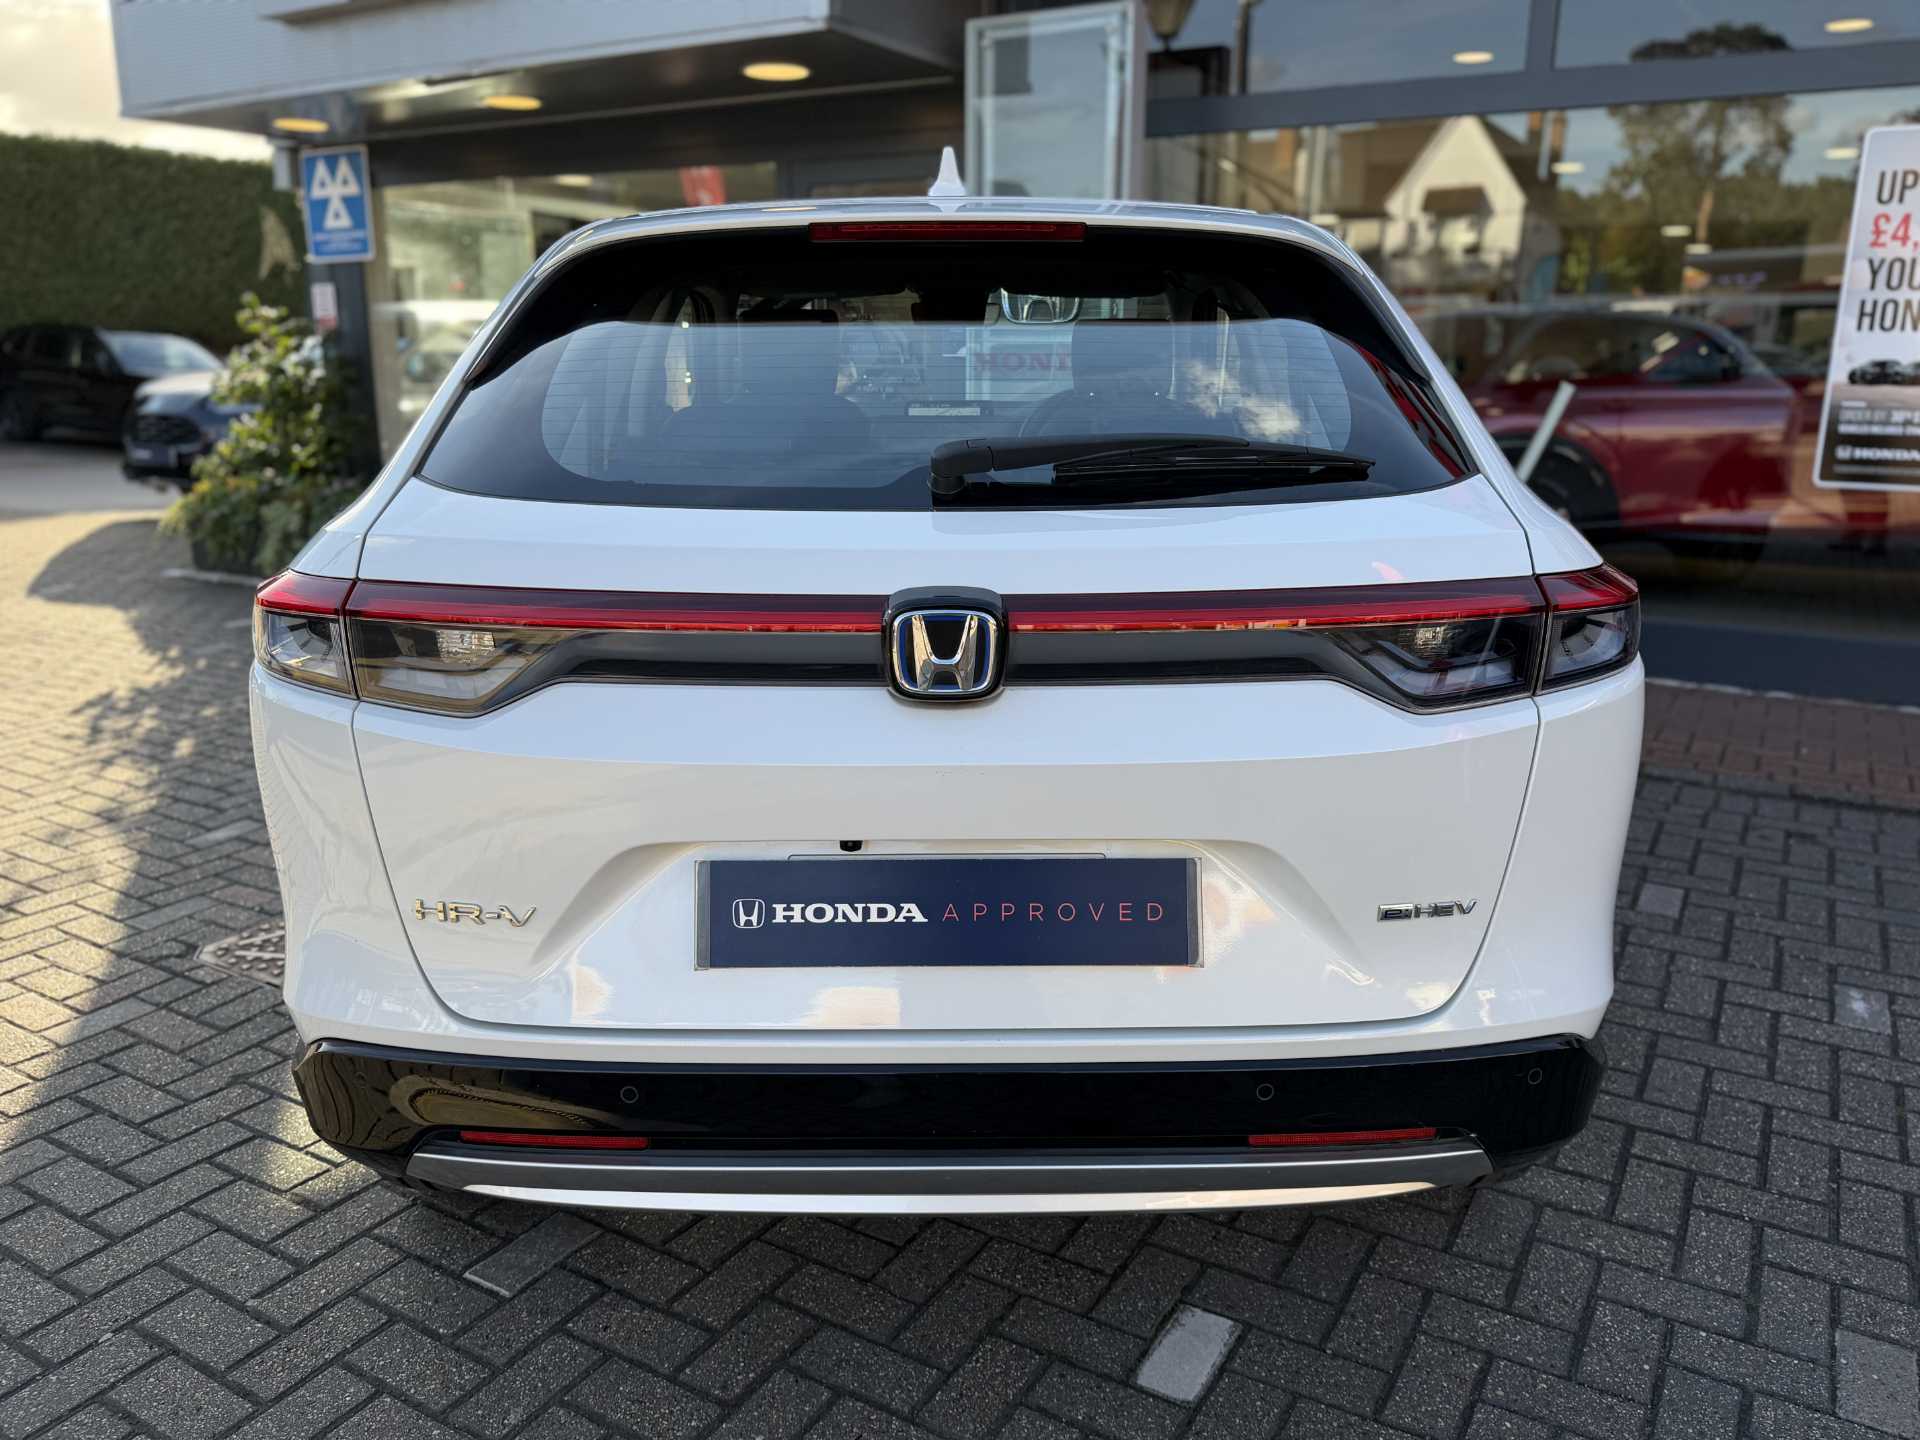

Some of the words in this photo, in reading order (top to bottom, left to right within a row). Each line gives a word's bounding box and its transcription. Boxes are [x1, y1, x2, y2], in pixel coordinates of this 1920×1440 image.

[1876, 169, 1919, 205] UP
[415, 898, 537, 928] HR-V
[771, 903, 929, 924] HONDA
[942, 902, 1164, 922] APPROVED
